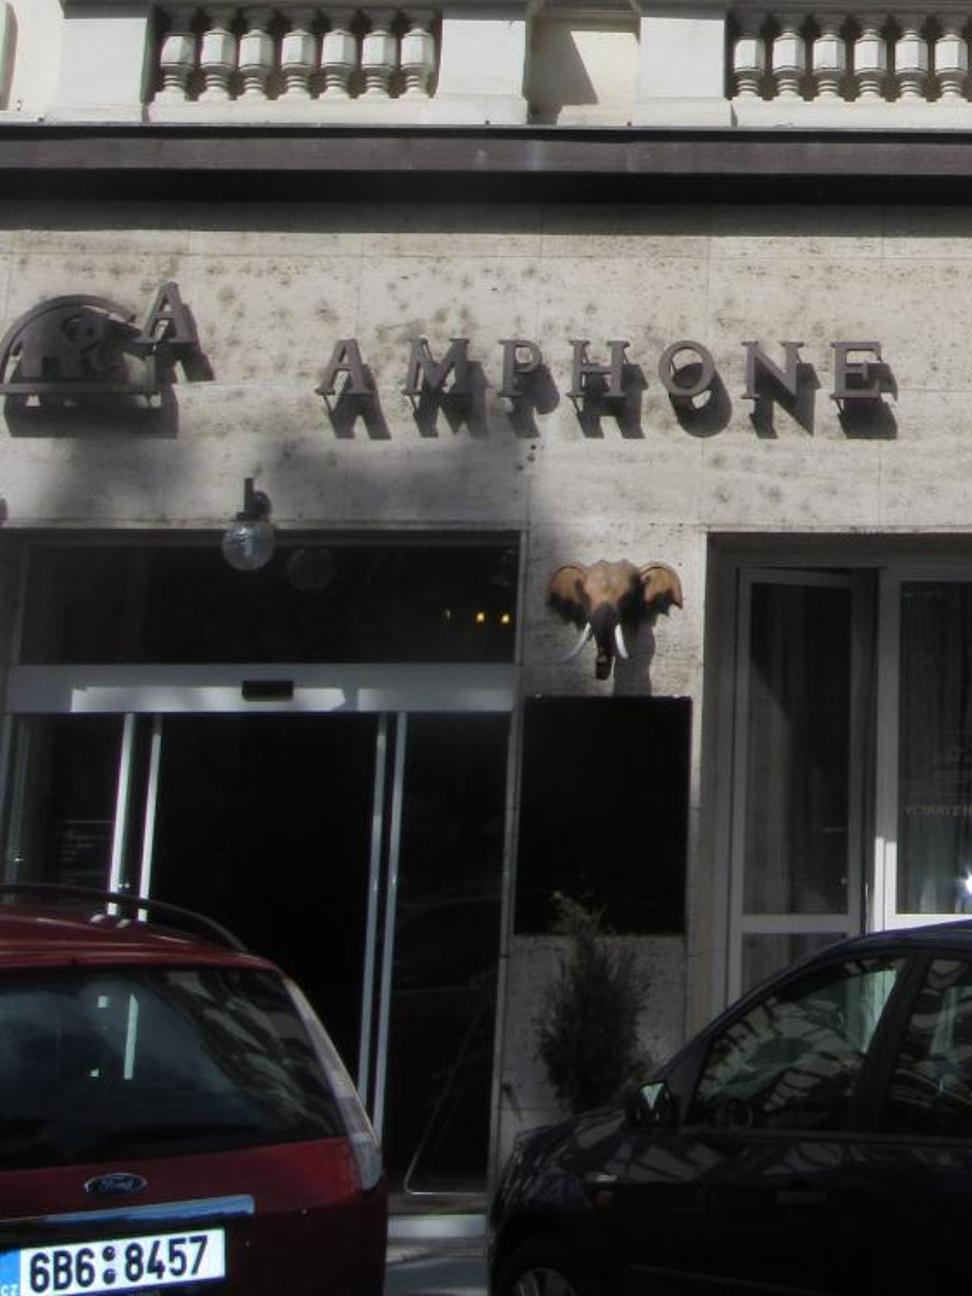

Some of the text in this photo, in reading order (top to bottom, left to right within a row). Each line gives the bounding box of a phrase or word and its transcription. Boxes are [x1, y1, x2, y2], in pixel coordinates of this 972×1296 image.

[316, 338, 886, 400] AMPHONE
[29, 1235, 209, 1294] 6B6 8457
